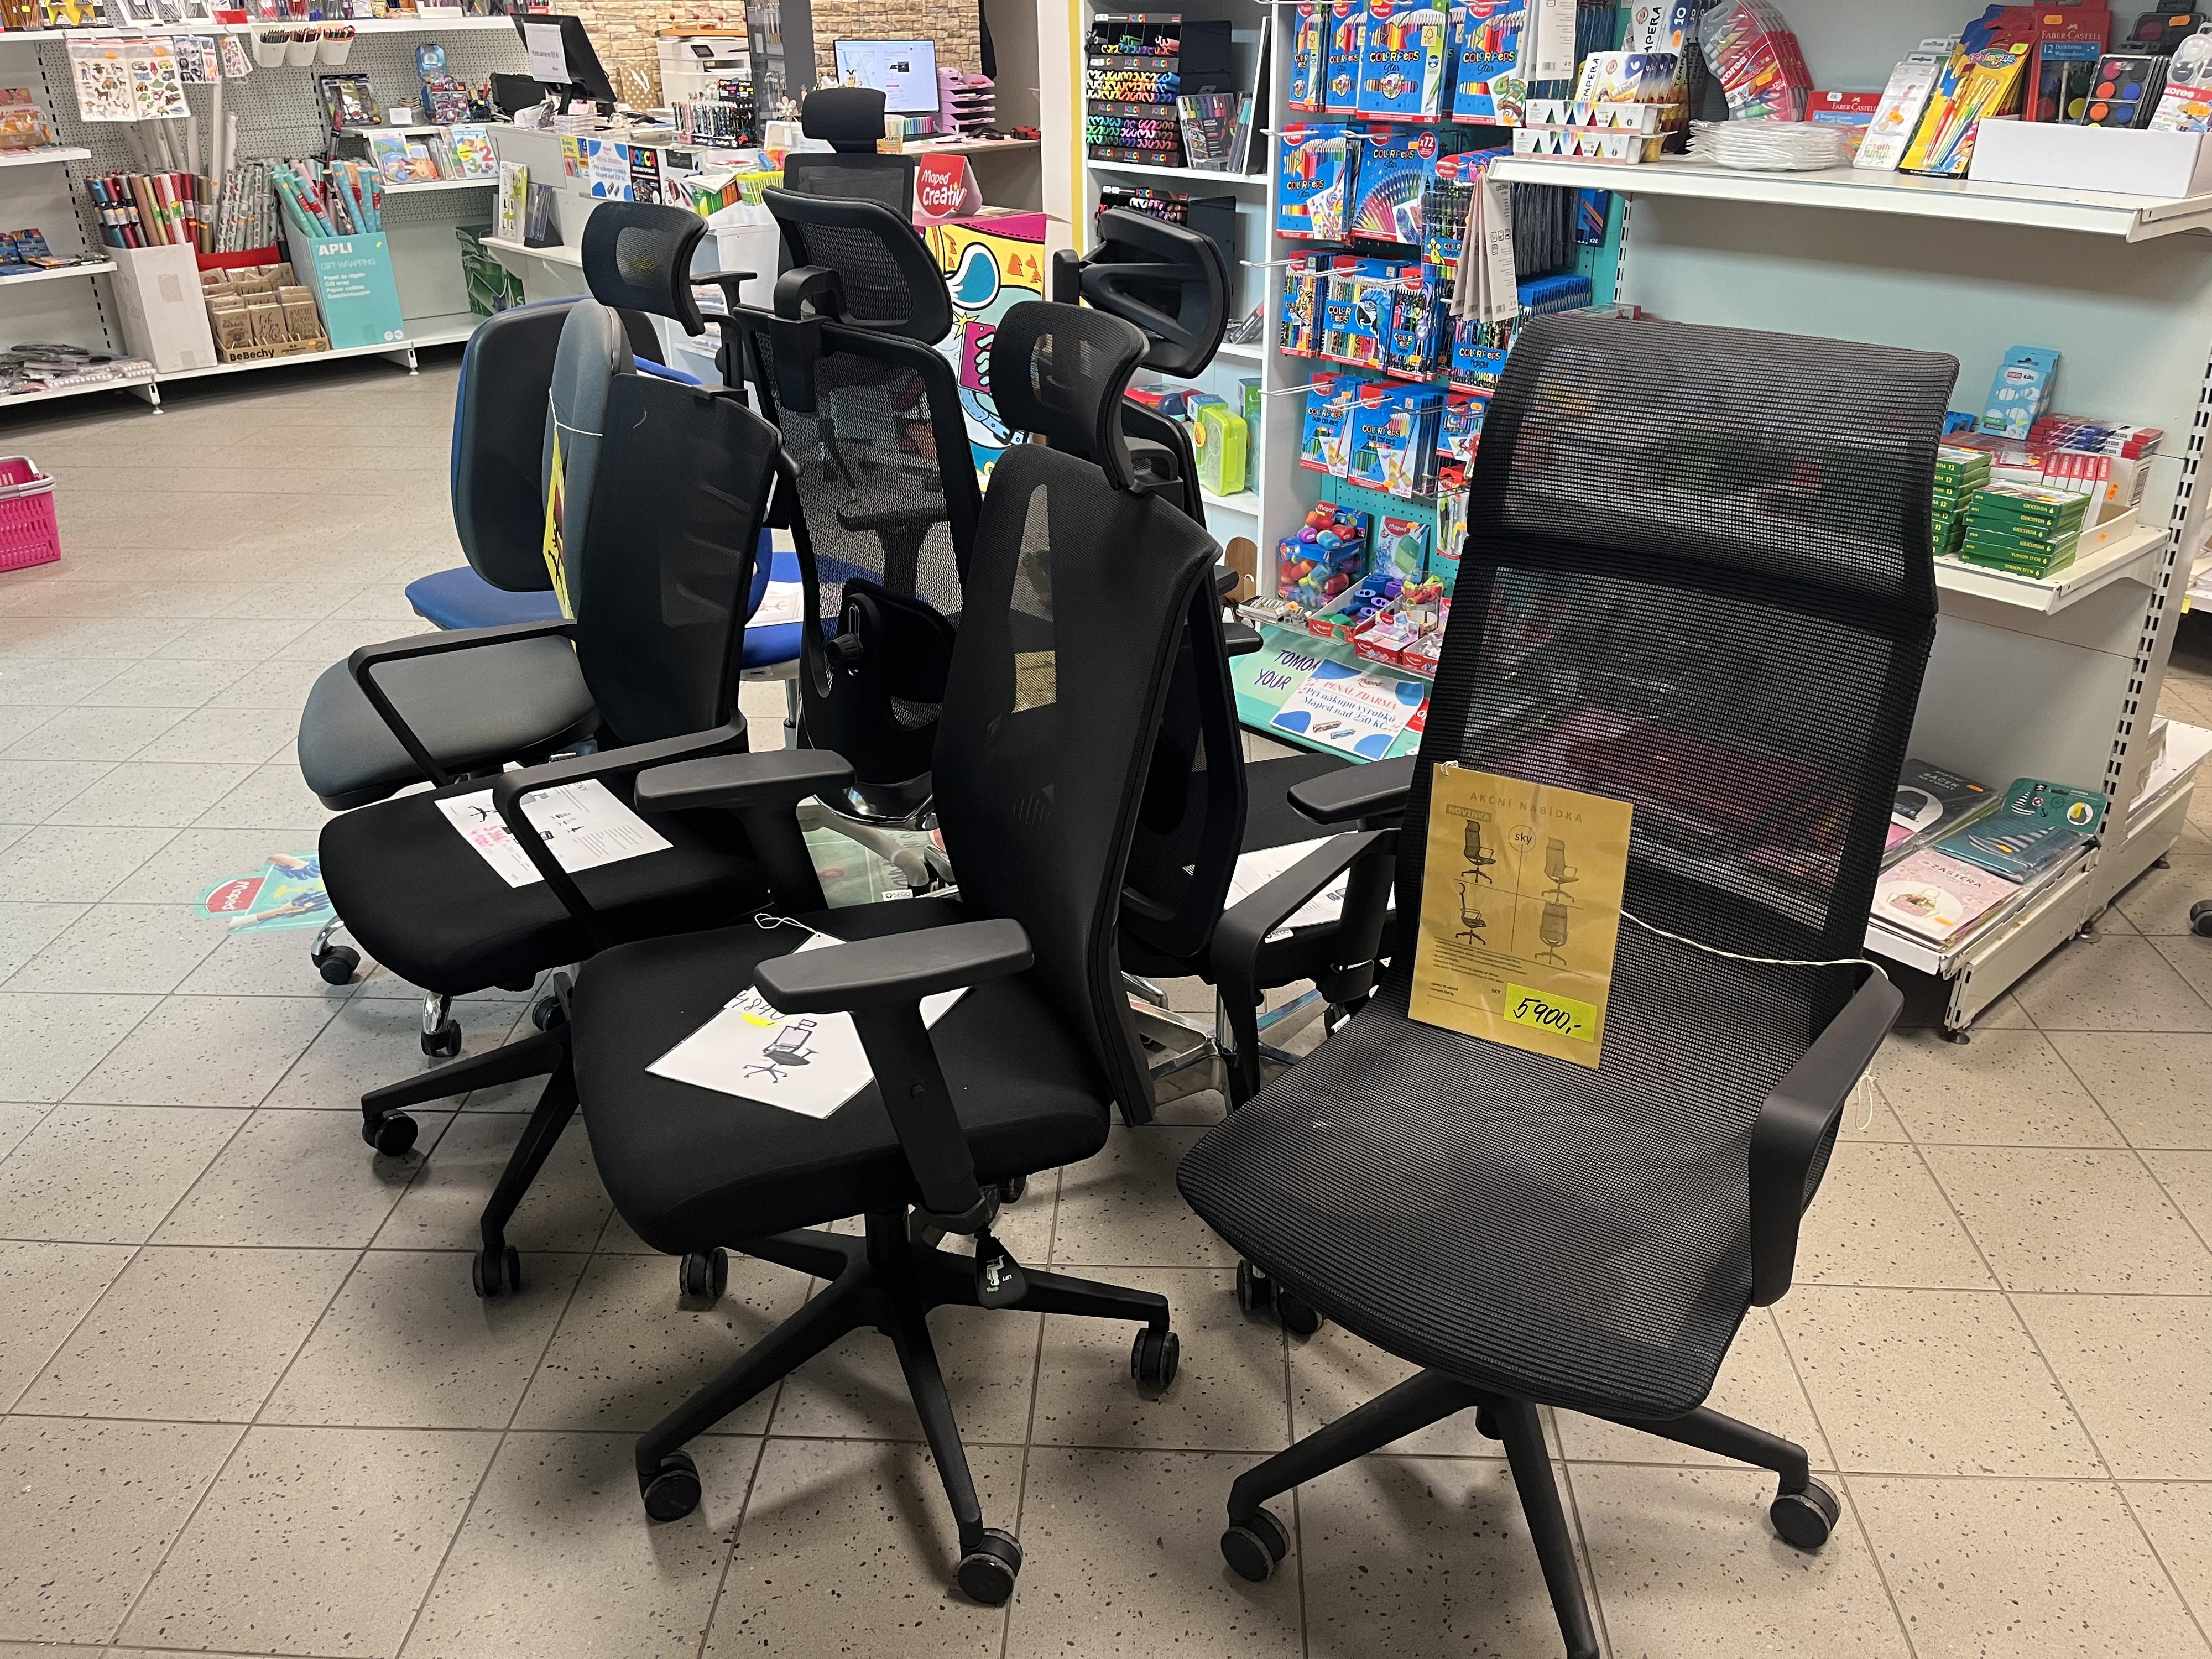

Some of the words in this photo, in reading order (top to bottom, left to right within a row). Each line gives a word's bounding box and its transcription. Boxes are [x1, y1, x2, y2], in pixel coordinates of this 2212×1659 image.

[1129, 14, 1146, 23] POSCA
[1674, 7, 1686, 25] 10
[2042, 30, 2101, 40] FABER-CASTELL
[2044, 44, 2053, 53] 12
[1384, 62, 1399, 73] Star
[1477, 64, 1494, 74] Star
[1630, 61, 1640, 71] 6
[1420, 137, 1433, 148] x72
[630, 149, 656, 167] POSCA
[921, 169, 951, 185] Maped
[922, 184, 966, 207] Creativ
[319, 242, 353, 255] APLI
[321, 262, 336, 270] GIFT
[338, 258, 376, 268] WRAPPING
[229, 348, 274, 361] BeBechy
[1378, 436, 1396, 446] COLORS
[1317, 504, 1337, 513] Maped
[1388, 524, 1407, 532] Maped
[1254, 668, 1292, 690] YOUR
[1358, 677, 1383, 687] Maped
[1354, 689, 1397, 710] ZDARMA
[1303, 697, 1333, 713] Maped
[1336, 706, 1352, 718] nad
[1353, 713, 1372, 726] 250
[1470, 791, 1512, 808] AKČNÍ
[1520, 802, 1583, 823] NABÍDKA
[1448, 806, 1490, 822] NOVINKA
[1515, 832, 1532, 844] sky
[222, 880, 250, 911] Maped
[1272, 928, 1289, 937] SEGO
